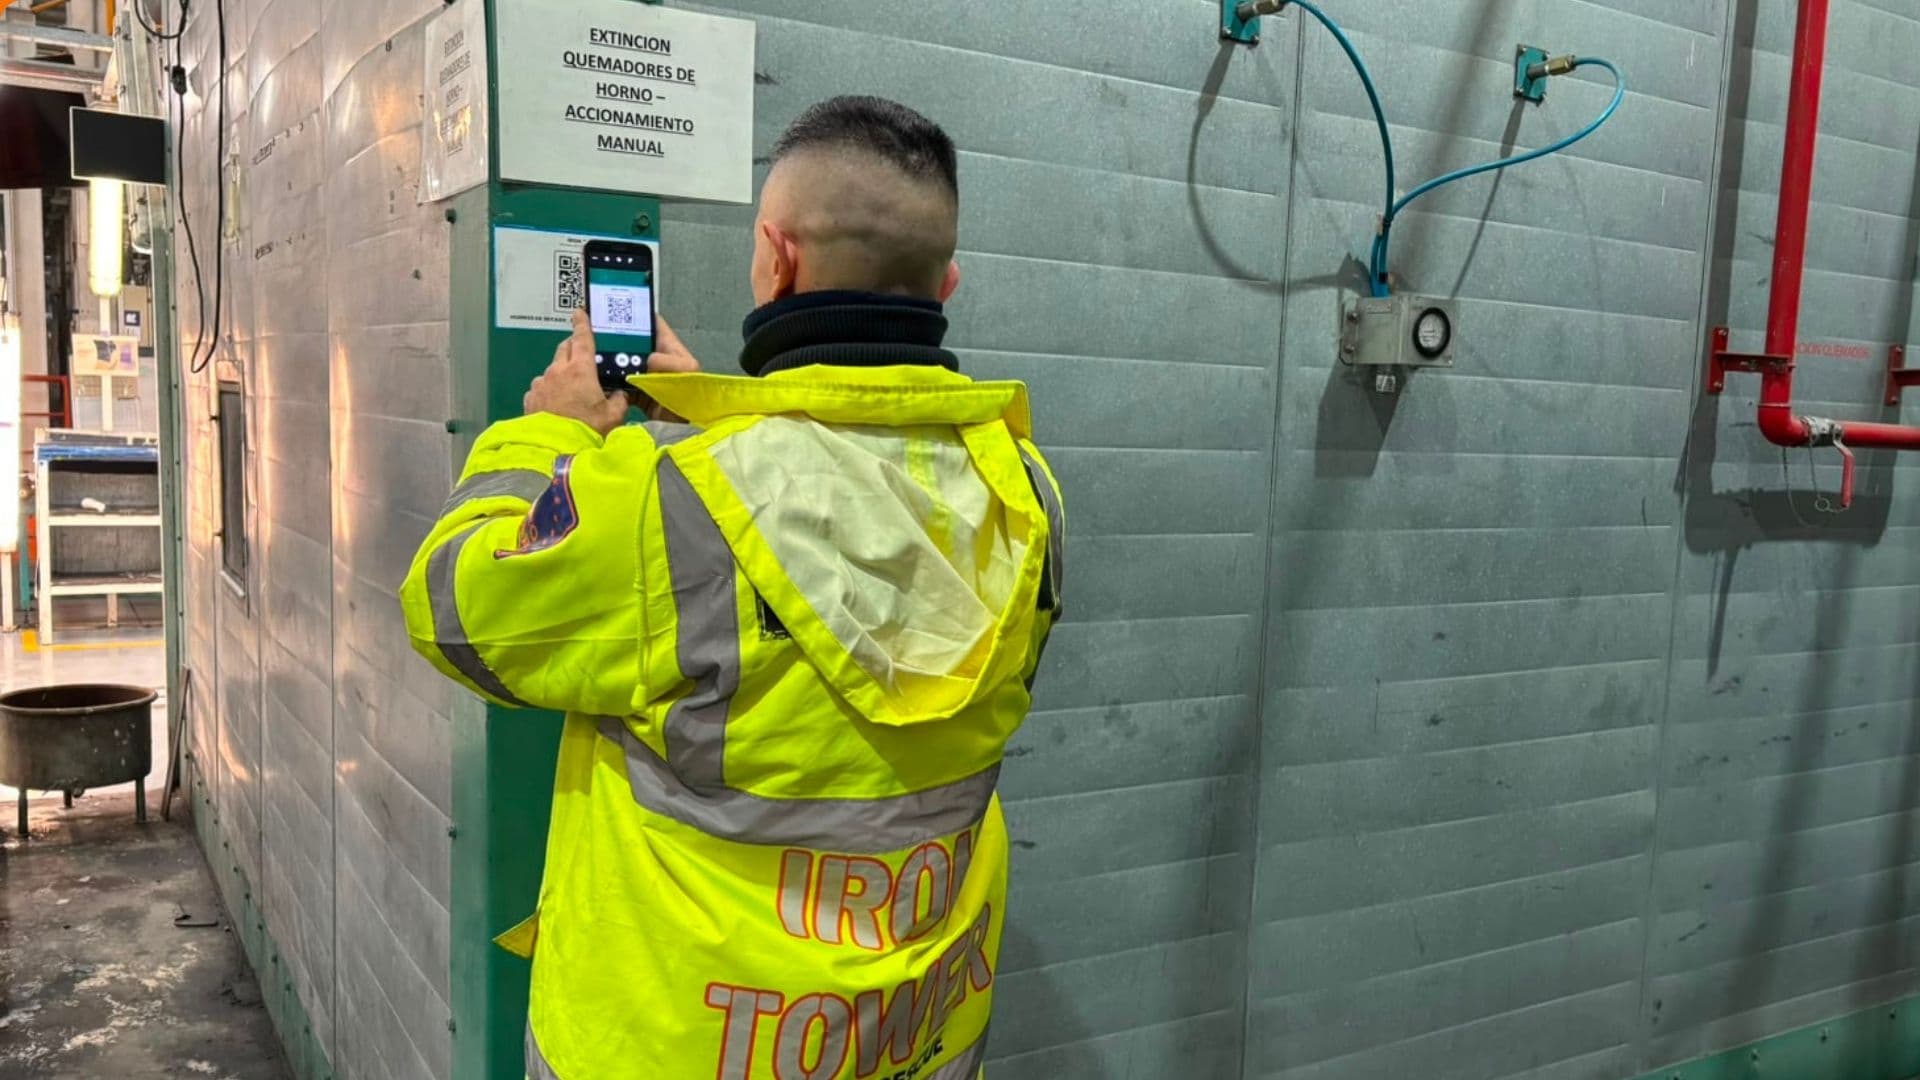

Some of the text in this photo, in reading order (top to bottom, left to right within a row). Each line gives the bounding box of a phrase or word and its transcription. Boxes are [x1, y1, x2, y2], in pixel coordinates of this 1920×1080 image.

[590, 27, 671, 55] EXTINCION
[563, 50, 696, 83] QUEMADORES DE
[596, 82, 653, 103] HORNO
[565, 103, 694, 134] ACCIONAMIENTO
[597, 134, 665, 156] MANUAL
[704, 901, 992, 1080] TOWER
